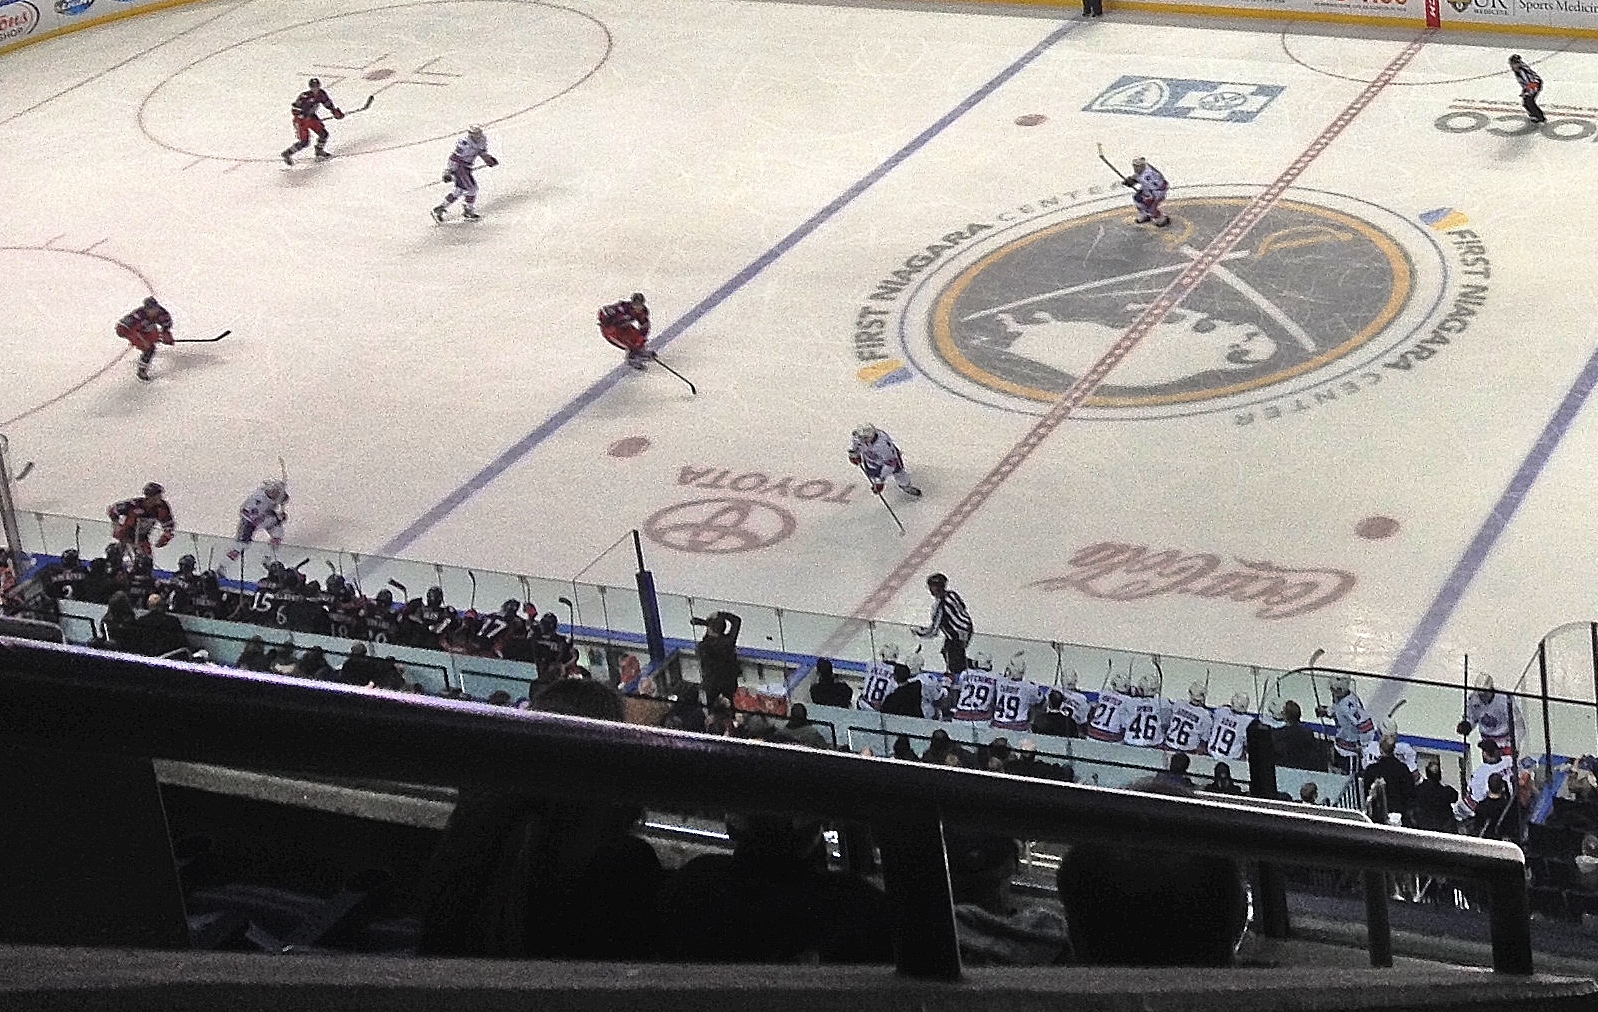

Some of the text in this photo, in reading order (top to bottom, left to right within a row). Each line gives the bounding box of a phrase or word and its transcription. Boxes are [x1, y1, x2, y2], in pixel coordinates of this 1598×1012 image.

[868, 222, 994, 303] NIAGARA
[1445, 228, 1491, 281] FIRST
[854, 305, 889, 362] FIRST
[1383, 283, 1491, 372] NIAGARA
[677, 465, 857, 506] TOYOTA
[251, 590, 275, 613] 15
[276, 605, 287, 625] 6
[864, 675, 888, 704] 18
[961, 683, 990, 708] 29
[995, 695, 1021, 720] 49
[1128, 712, 1158, 741] 46
[1166, 716, 1194, 746] 26
[1209, 724, 1237, 757] 19
